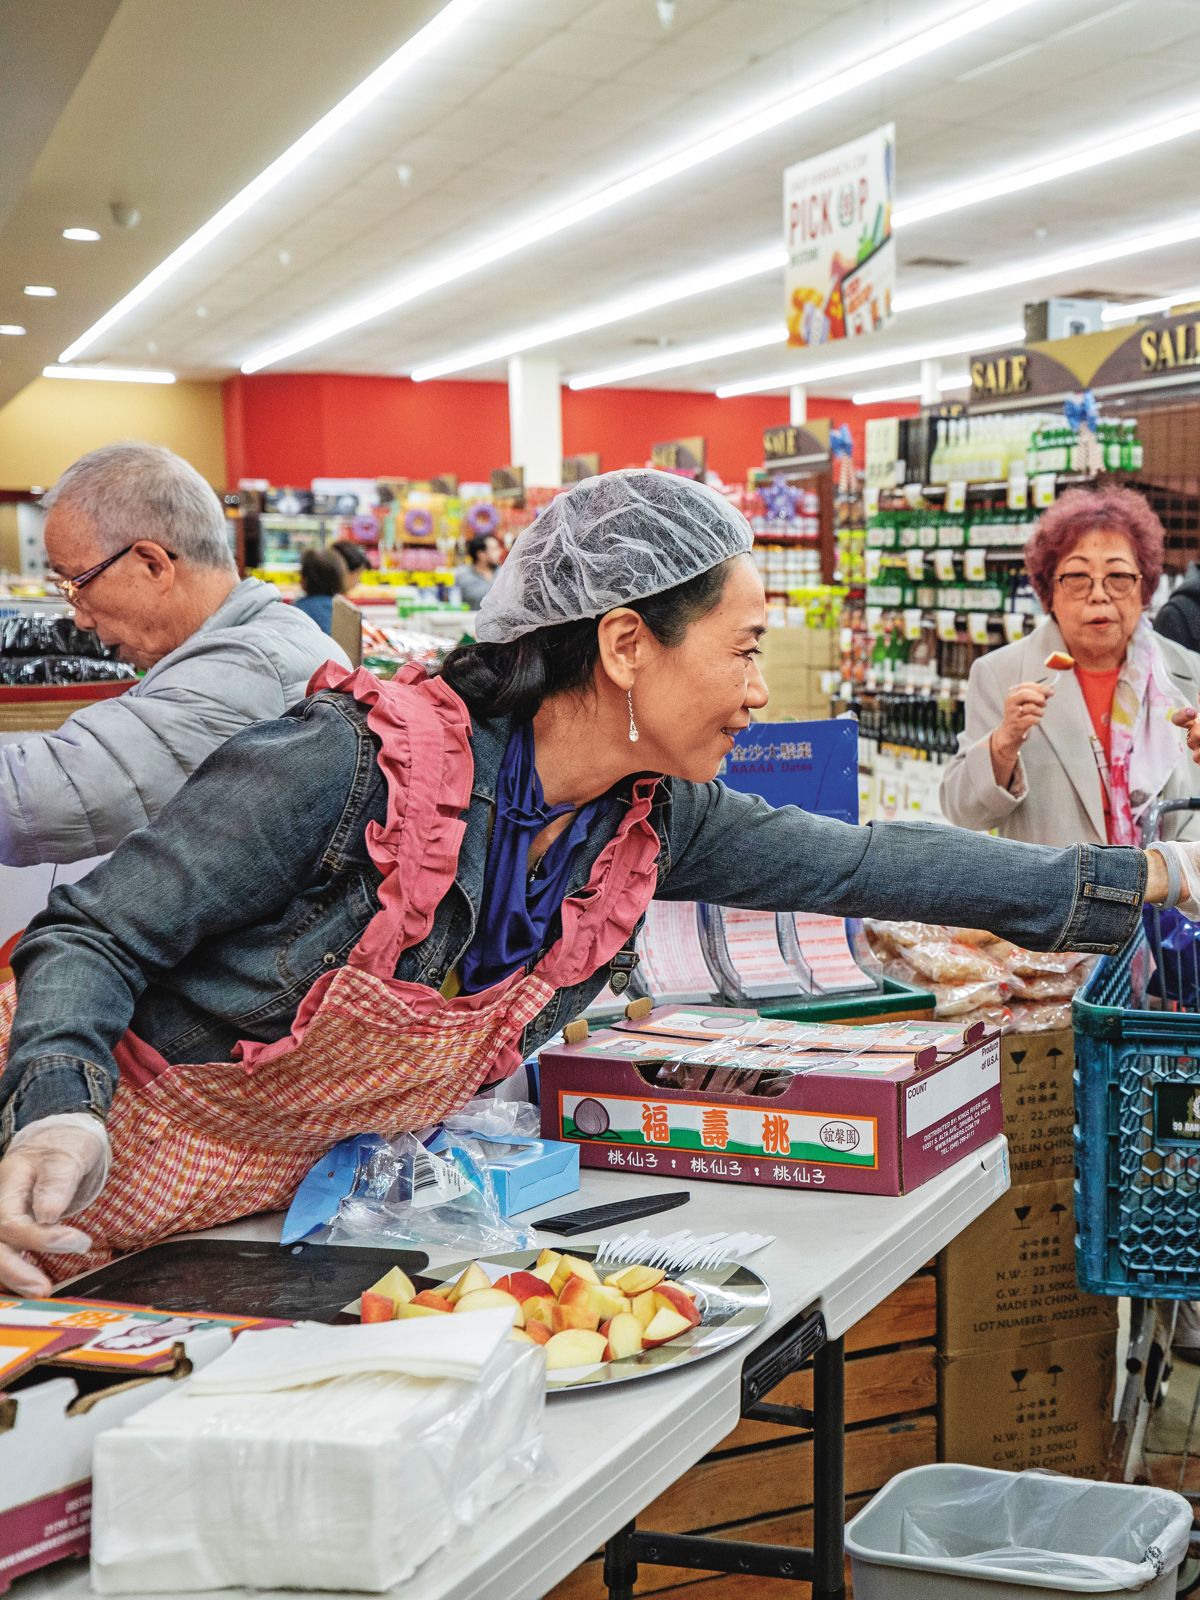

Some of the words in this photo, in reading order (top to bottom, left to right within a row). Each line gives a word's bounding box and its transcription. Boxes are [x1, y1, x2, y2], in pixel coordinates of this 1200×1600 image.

[790, 188, 833, 245] PICK
[971, 354, 1029, 394] SALE
[981, 1041, 999, 1057] Produce
[981, 1059, 987, 1070] of
[907, 1081, 928, 1099] COUNT
[1031, 1106, 1074, 1121] 22.70KG
[923, 1121, 951, 1142] DISTRIBUTED
[1031, 1126, 1074, 1140] 23.50KG
[1172, 1121, 1183, 1132] 99
[822, 1127, 858, 1146] 誼馨園
[1043, 1138, 1074, 1151] CHIN
[607, 1149, 659, 1169] 桃仙子
[690, 1157, 743, 1177] 桃仙子
[772, 1164, 826, 1184] 桃仙子
[1032, 1262, 1075, 1278] 22.70KG
[1032, 1280, 1077, 1296] 23.50KG
[996, 1299, 1030, 1313] MADE
[1030, 1298, 1042, 1309] IN
[1044, 1293, 1080, 1307] CHINA
[972, 1320, 995, 1333] LOT
[994, 1314, 1048, 1329] NUMBER:
